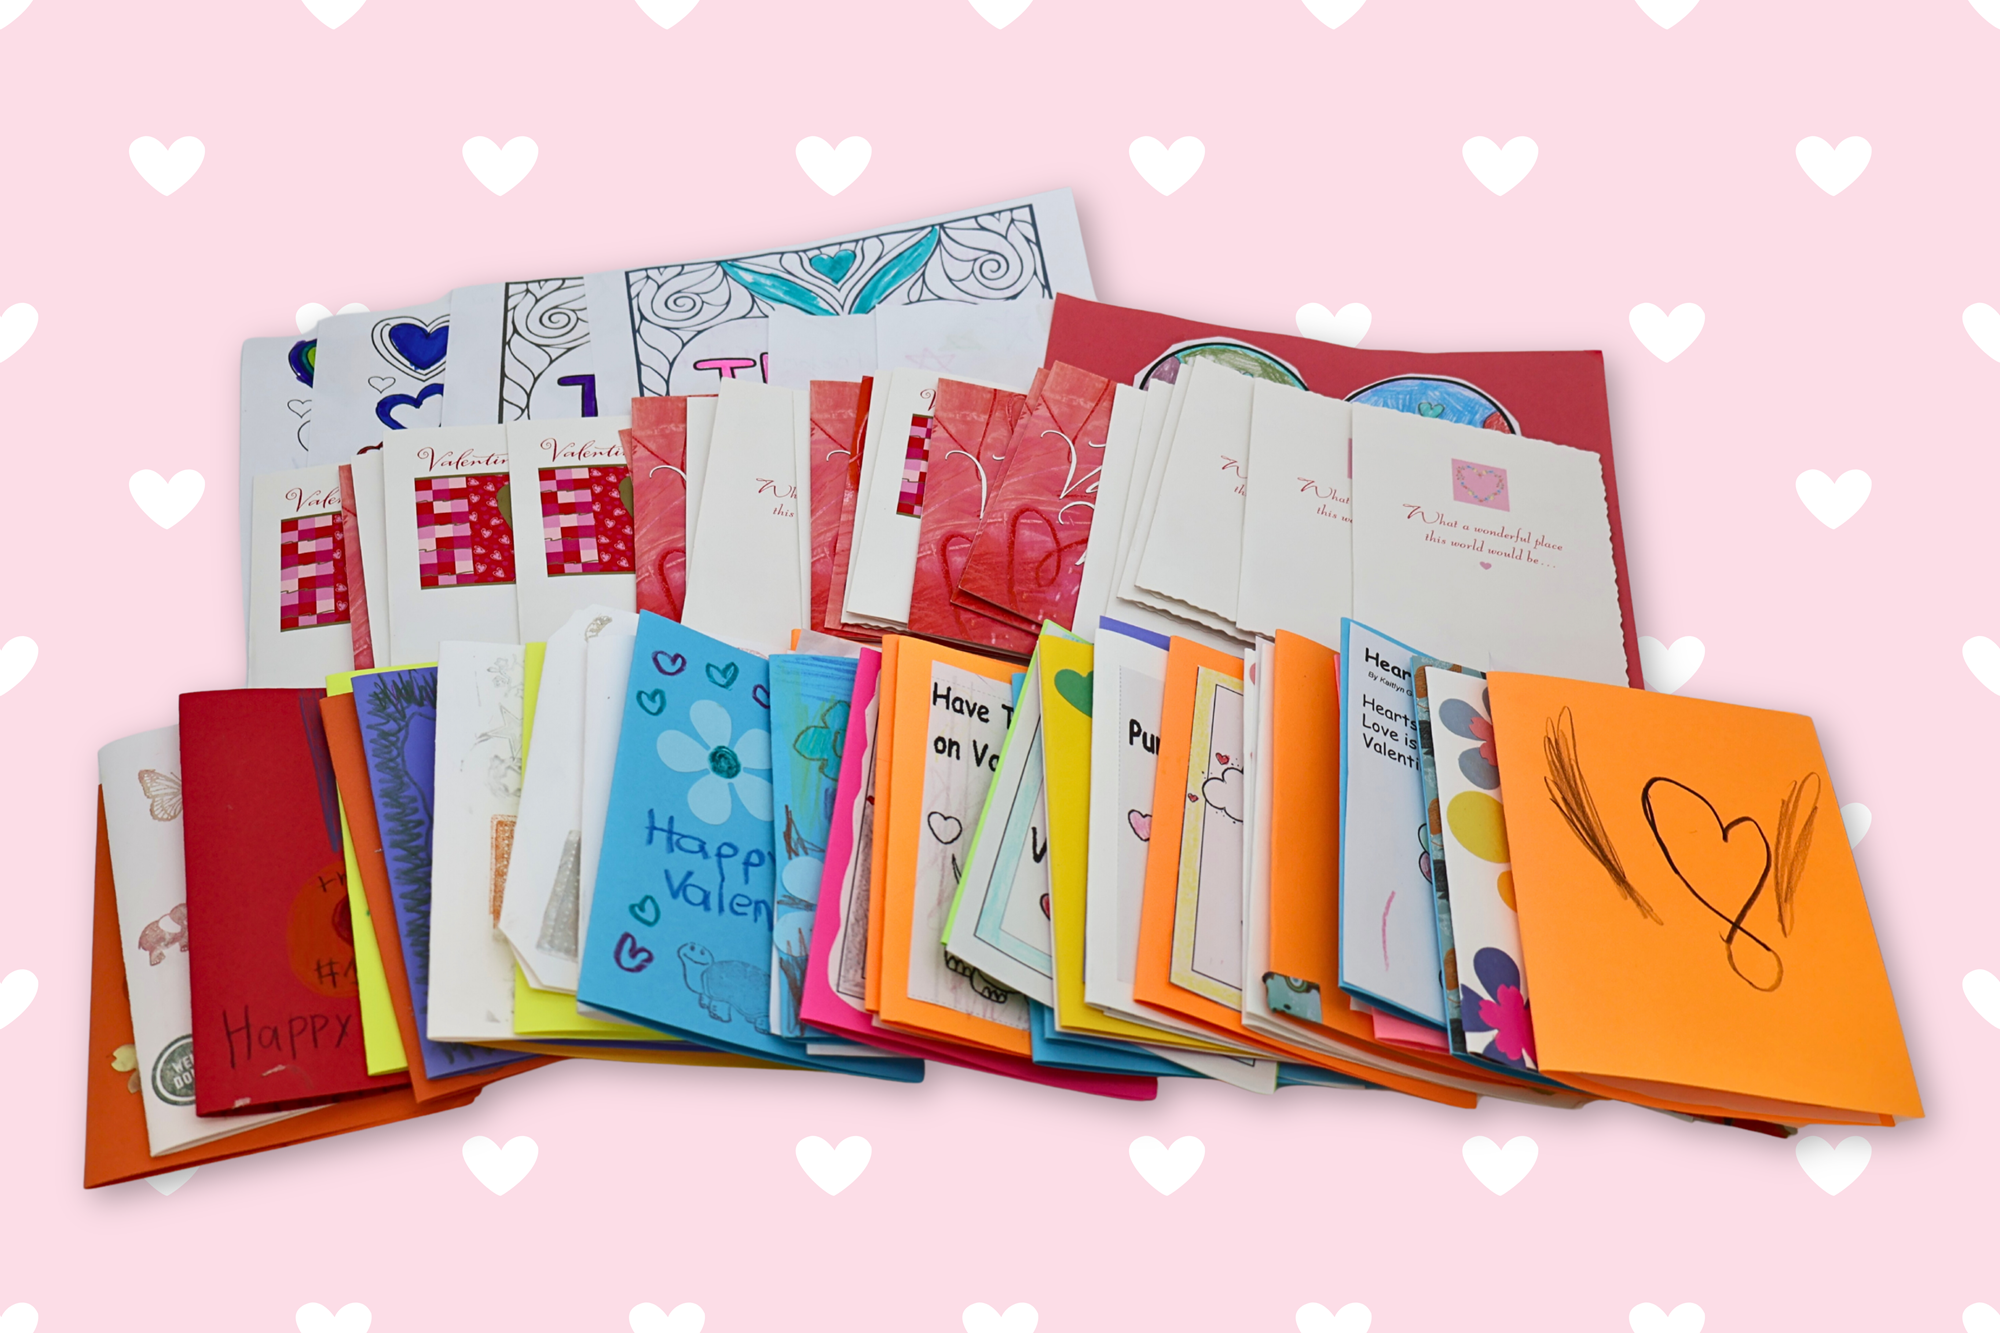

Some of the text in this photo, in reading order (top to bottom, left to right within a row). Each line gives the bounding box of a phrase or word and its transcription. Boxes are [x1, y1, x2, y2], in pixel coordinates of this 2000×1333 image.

[540, 437, 625, 462] Valenti
[285, 487, 341, 512] Vale
[1297, 477, 1350, 504] What
[772, 503, 795, 518] this
[1316, 504, 1337, 519] this
[1402, 503, 1458, 528] What
[1474, 526, 1531, 544] wonderful
[1533, 535, 1564, 551] place
[1425, 530, 1447, 545] this
[1450, 538, 1485, 552] world
[1487, 547, 1523, 561] would
[1365, 647, 1411, 680] Hear
[1368, 670, 1379, 681] By
[1380, 677, 1405, 692] Kaitlyn
[932, 682, 990, 724] Have
[1362, 693, 1418, 732] Hearts
[1362, 713, 1417, 750] Love is
[933, 736, 961, 761] on
[1362, 732, 1420, 771] Valenti
